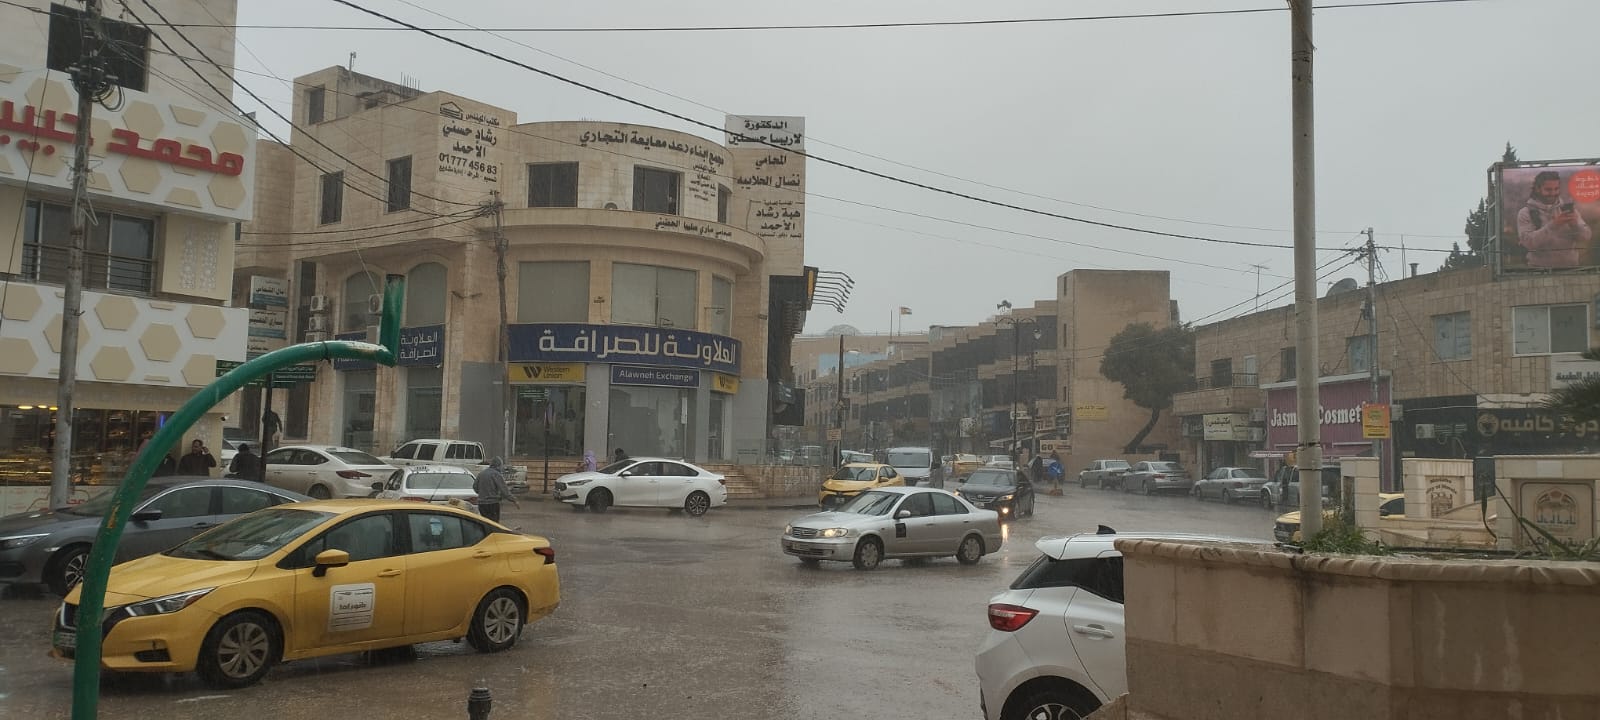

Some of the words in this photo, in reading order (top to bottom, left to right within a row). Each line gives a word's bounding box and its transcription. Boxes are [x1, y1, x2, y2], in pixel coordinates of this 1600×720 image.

[443, 120, 472, 137] حسني
[744, 119, 788, 130] الدكتورة
[475, 128, 497, 146] رشاد
[580, 129, 629, 147] التجاري
[770, 133, 803, 146] لاريسا
[107, 128, 244, 176] محمد
[755, 154, 787, 170] المحامي
[774, 173, 801, 188] نضال
[756, 206, 779, 219] رشاد
[782, 207, 801, 219] هبة
[401, 332, 438, 346] العلاونة
[538, 328, 660, 359] للصرافة
[400, 346, 437, 361] للصرافة
[663, 332, 737, 366] العلاونة
[619, 370, 654, 380] Alawneh
[656, 372, 694, 383] Exchange
[1271, 408, 1297, 427] Jasm
[1318, 404, 1362, 425] Cosmet
[1500, 413, 1554, 437] كافيه
